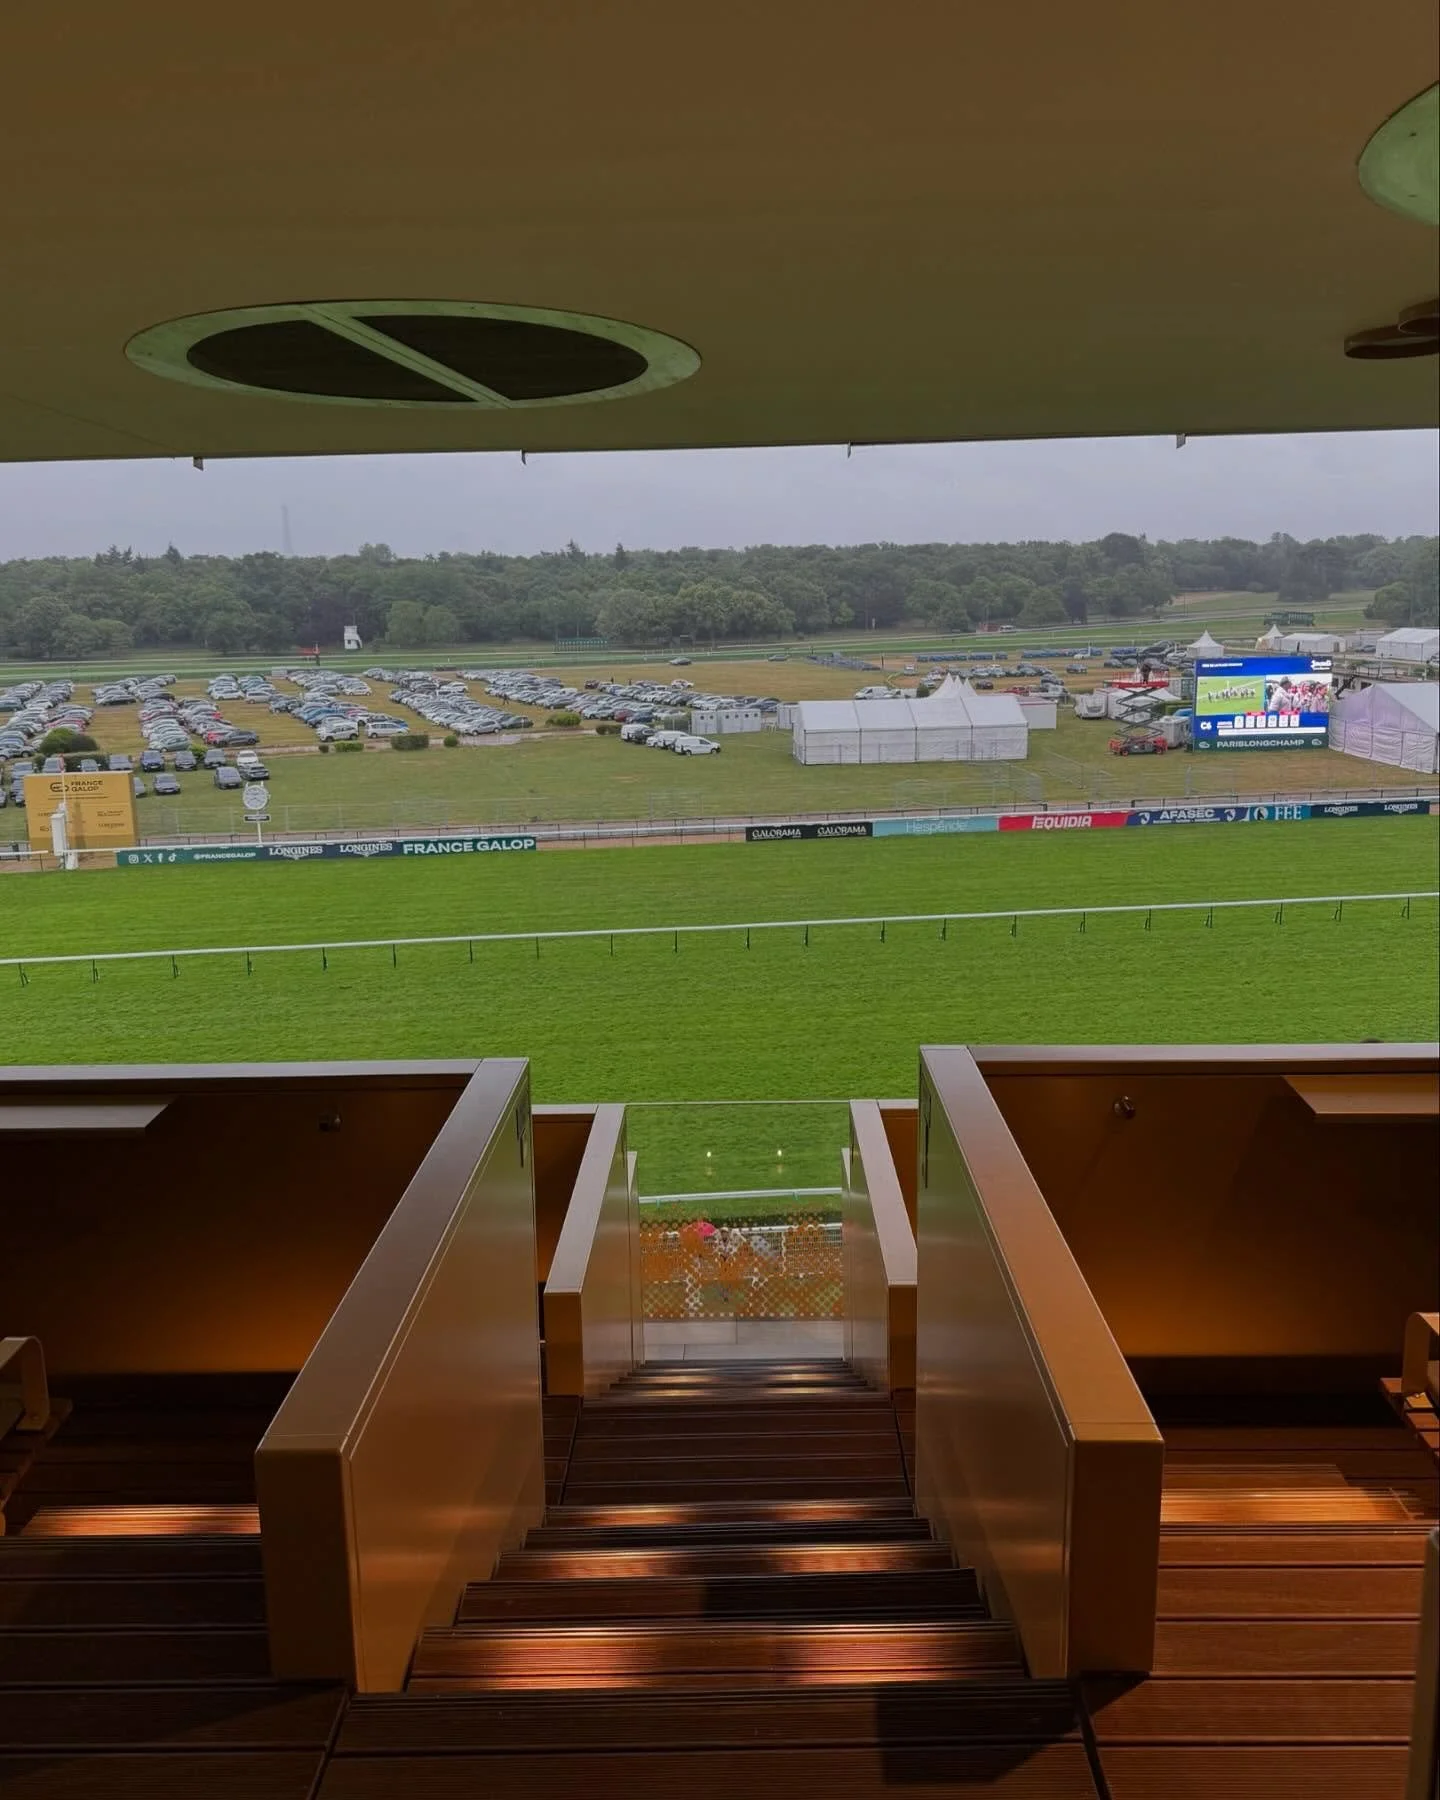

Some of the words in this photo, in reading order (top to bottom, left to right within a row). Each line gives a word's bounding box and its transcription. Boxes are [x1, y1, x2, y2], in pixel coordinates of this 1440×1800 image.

[1216, 739, 1305, 749] PARISLONGCHAMP
[1160, 808, 1215, 820] AFASEC
[1031, 815, 1092, 830] EQUIDIA
[752, 828, 802, 838] GALORAMA
[817, 825, 867, 835] GALORAMA
[269, 845, 324, 856] LONGINES
[339, 842, 393, 853] LONGINES
[402, 840, 474, 855] FRANCE
[476, 838, 535, 852] GALOP
